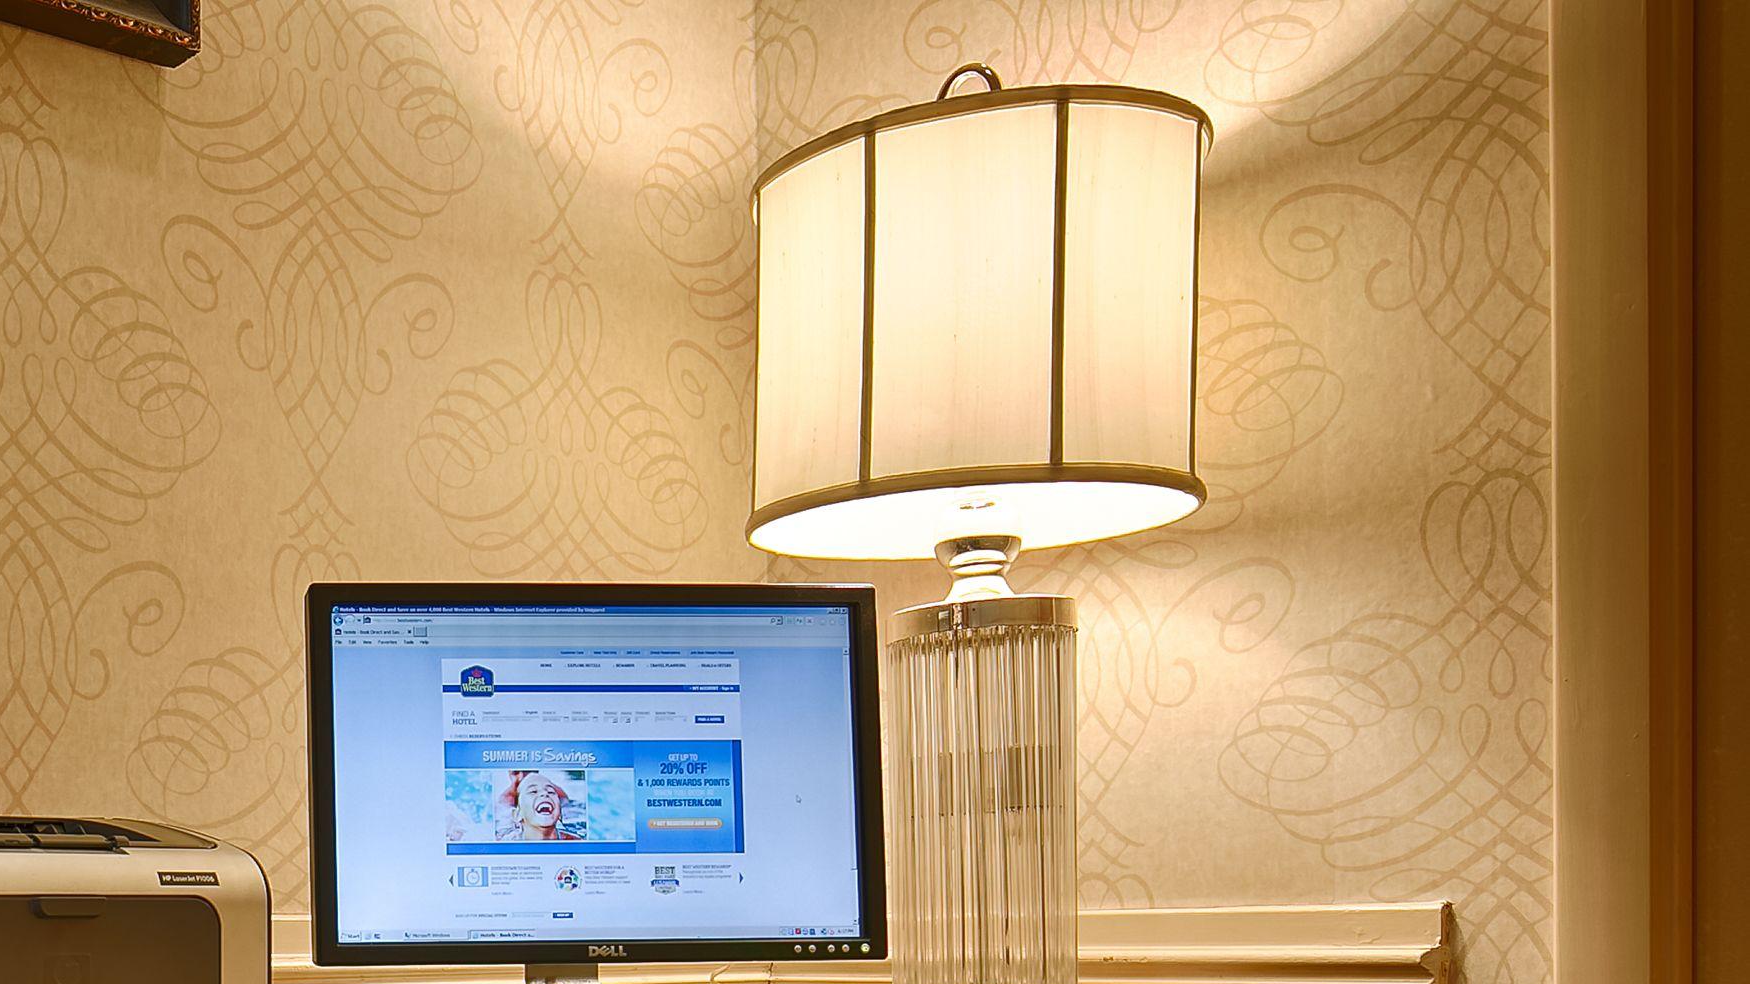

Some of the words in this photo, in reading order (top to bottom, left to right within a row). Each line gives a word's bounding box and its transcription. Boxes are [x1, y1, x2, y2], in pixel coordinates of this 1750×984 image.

[468, 677, 485, 685] Best
[461, 684, 492, 692] Western
[483, 750, 528, 763] SUMMER
[531, 750, 542, 763] IS
[544, 747, 598, 768] Savings
[668, 753, 679, 761] GET
[680, 753, 689, 761] UP
[690, 753, 698, 761] TO
[660, 762, 684, 774] 20%
[686, 762, 708, 774] OFF
[646, 779, 665, 788] 1,000
[667, 779, 702, 787] REWARDS
[704, 779, 730, 787] POINTS
[647, 798, 722, 807] BESTWESTERN.COM
[654, 866, 676, 874] BEST
[588, 945, 628, 957] DELL
